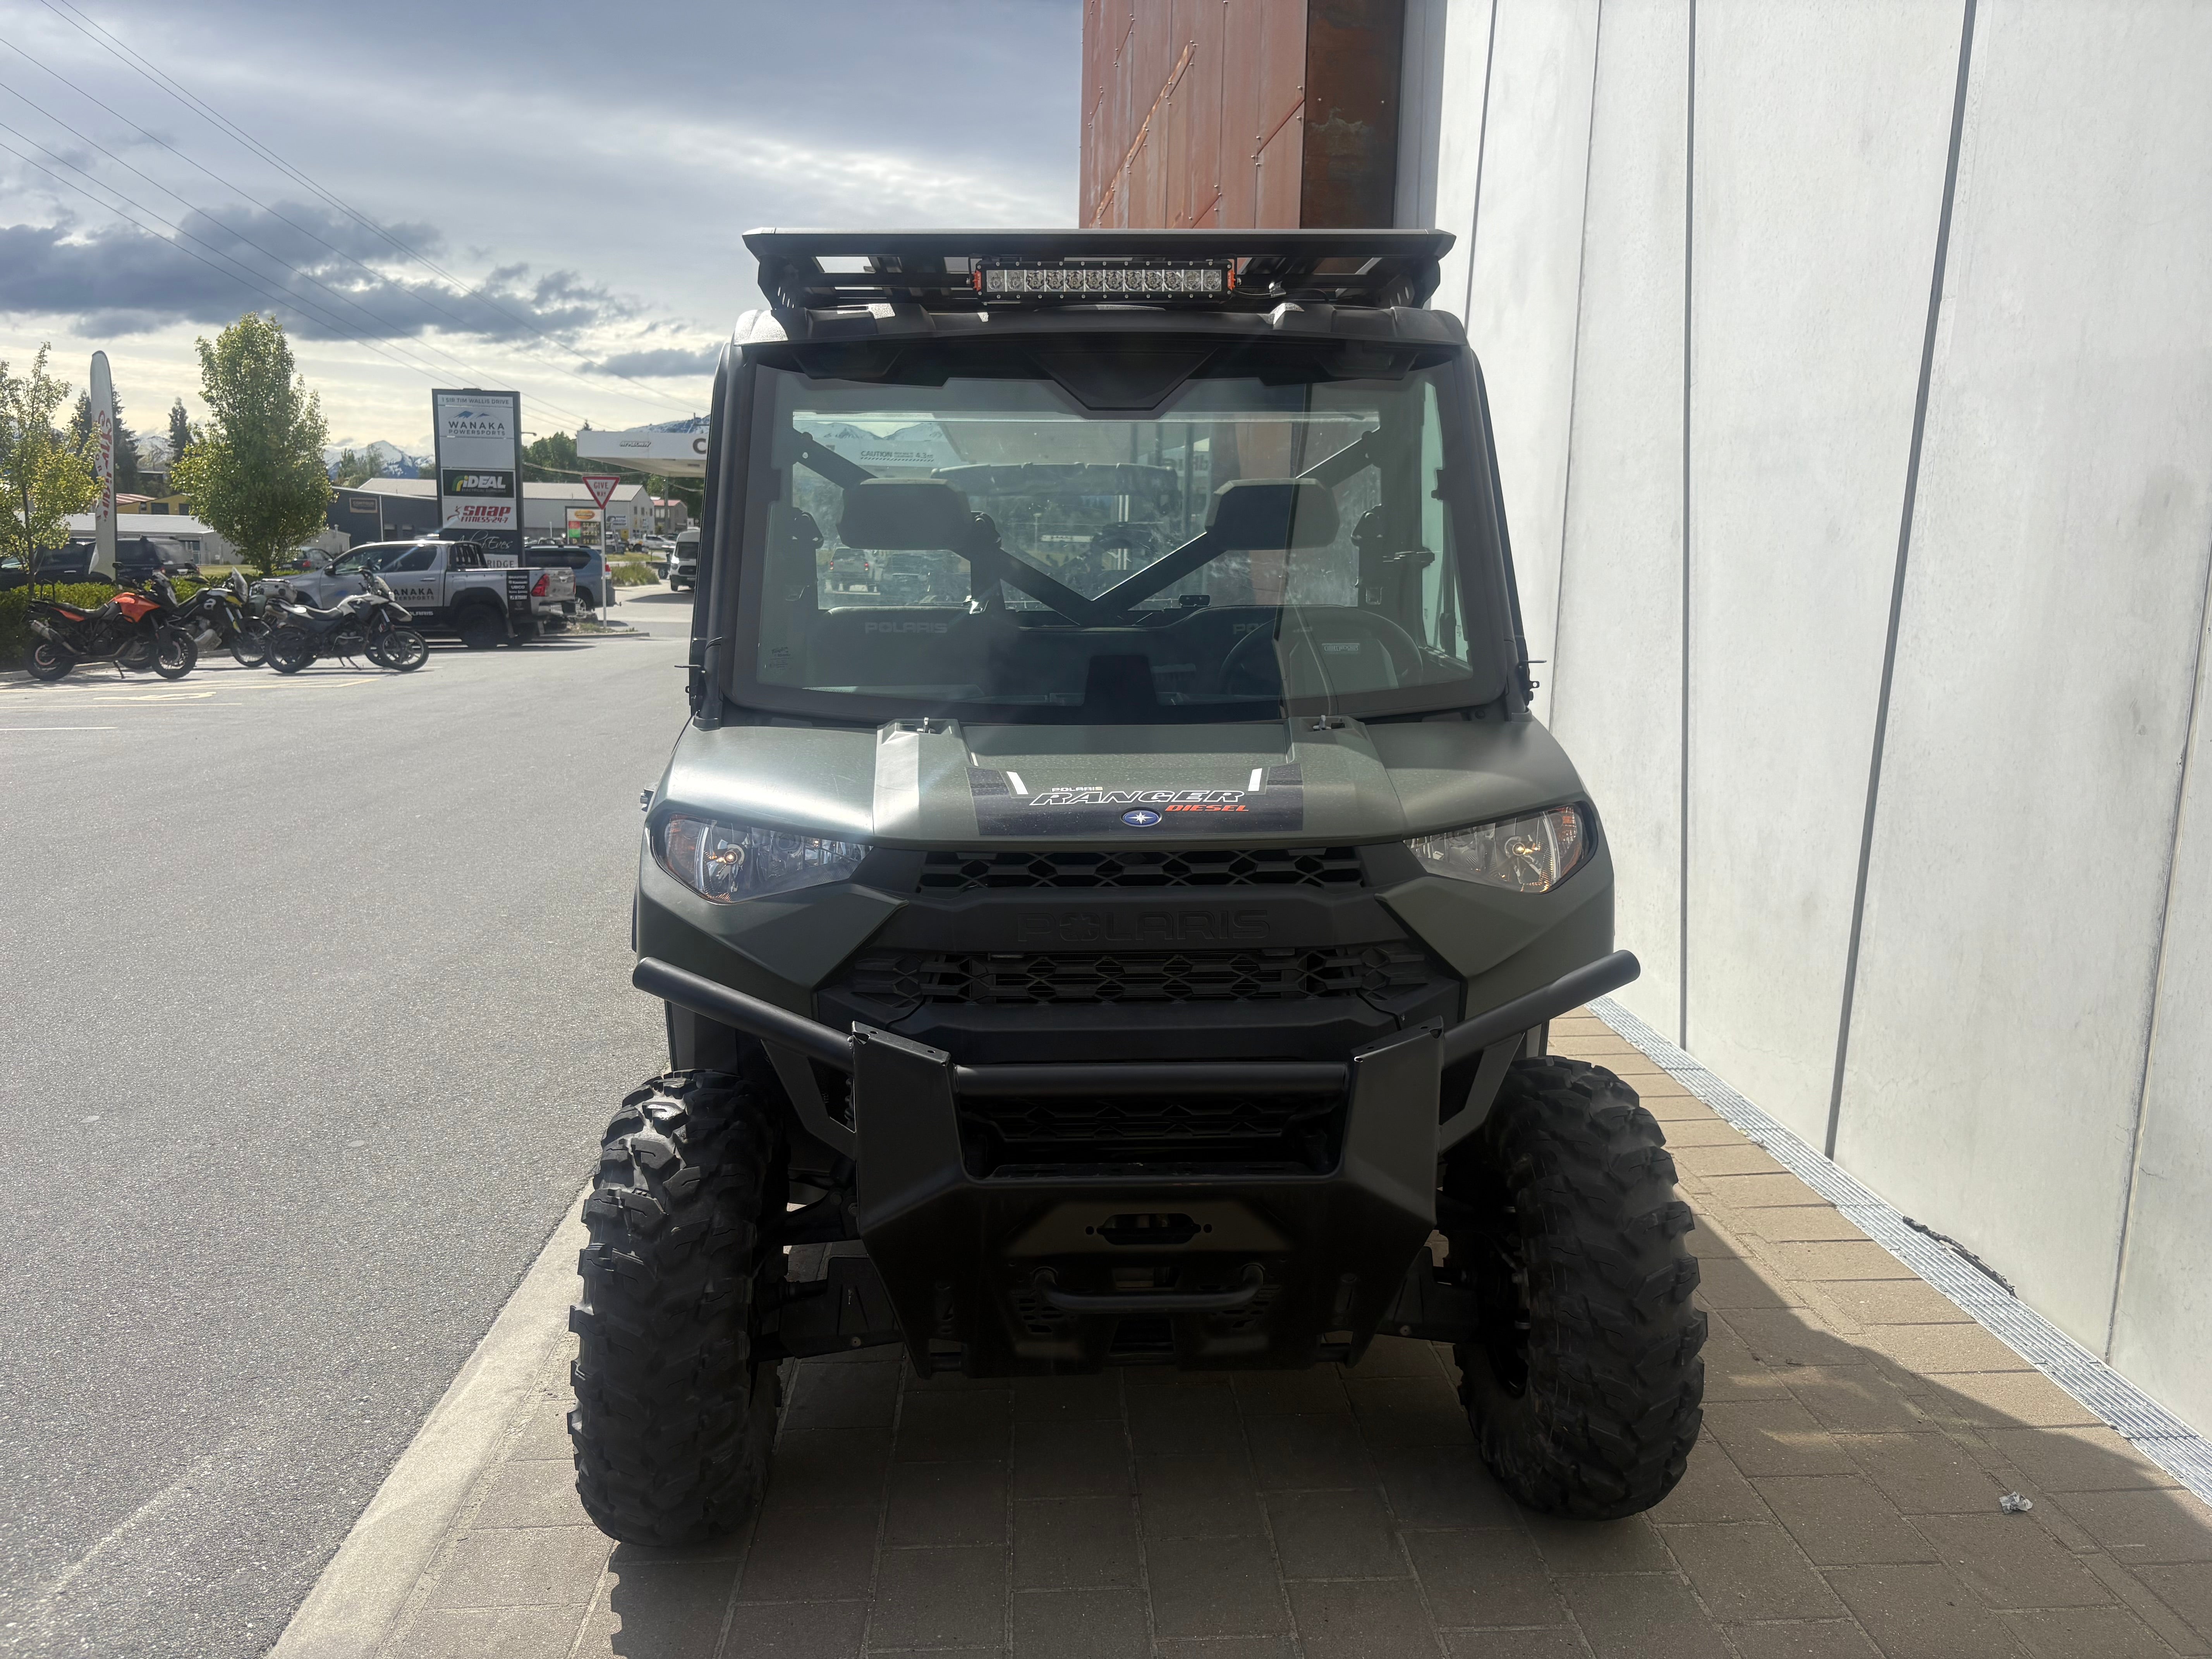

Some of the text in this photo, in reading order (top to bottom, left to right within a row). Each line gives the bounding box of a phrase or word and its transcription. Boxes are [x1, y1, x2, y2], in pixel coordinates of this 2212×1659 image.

[448, 421, 505, 430] WANAKA
[865, 622, 948, 634] POLARIS
[1029, 790, 1245, 805] RANGER
[1017, 910, 1271, 942] POLARIS
